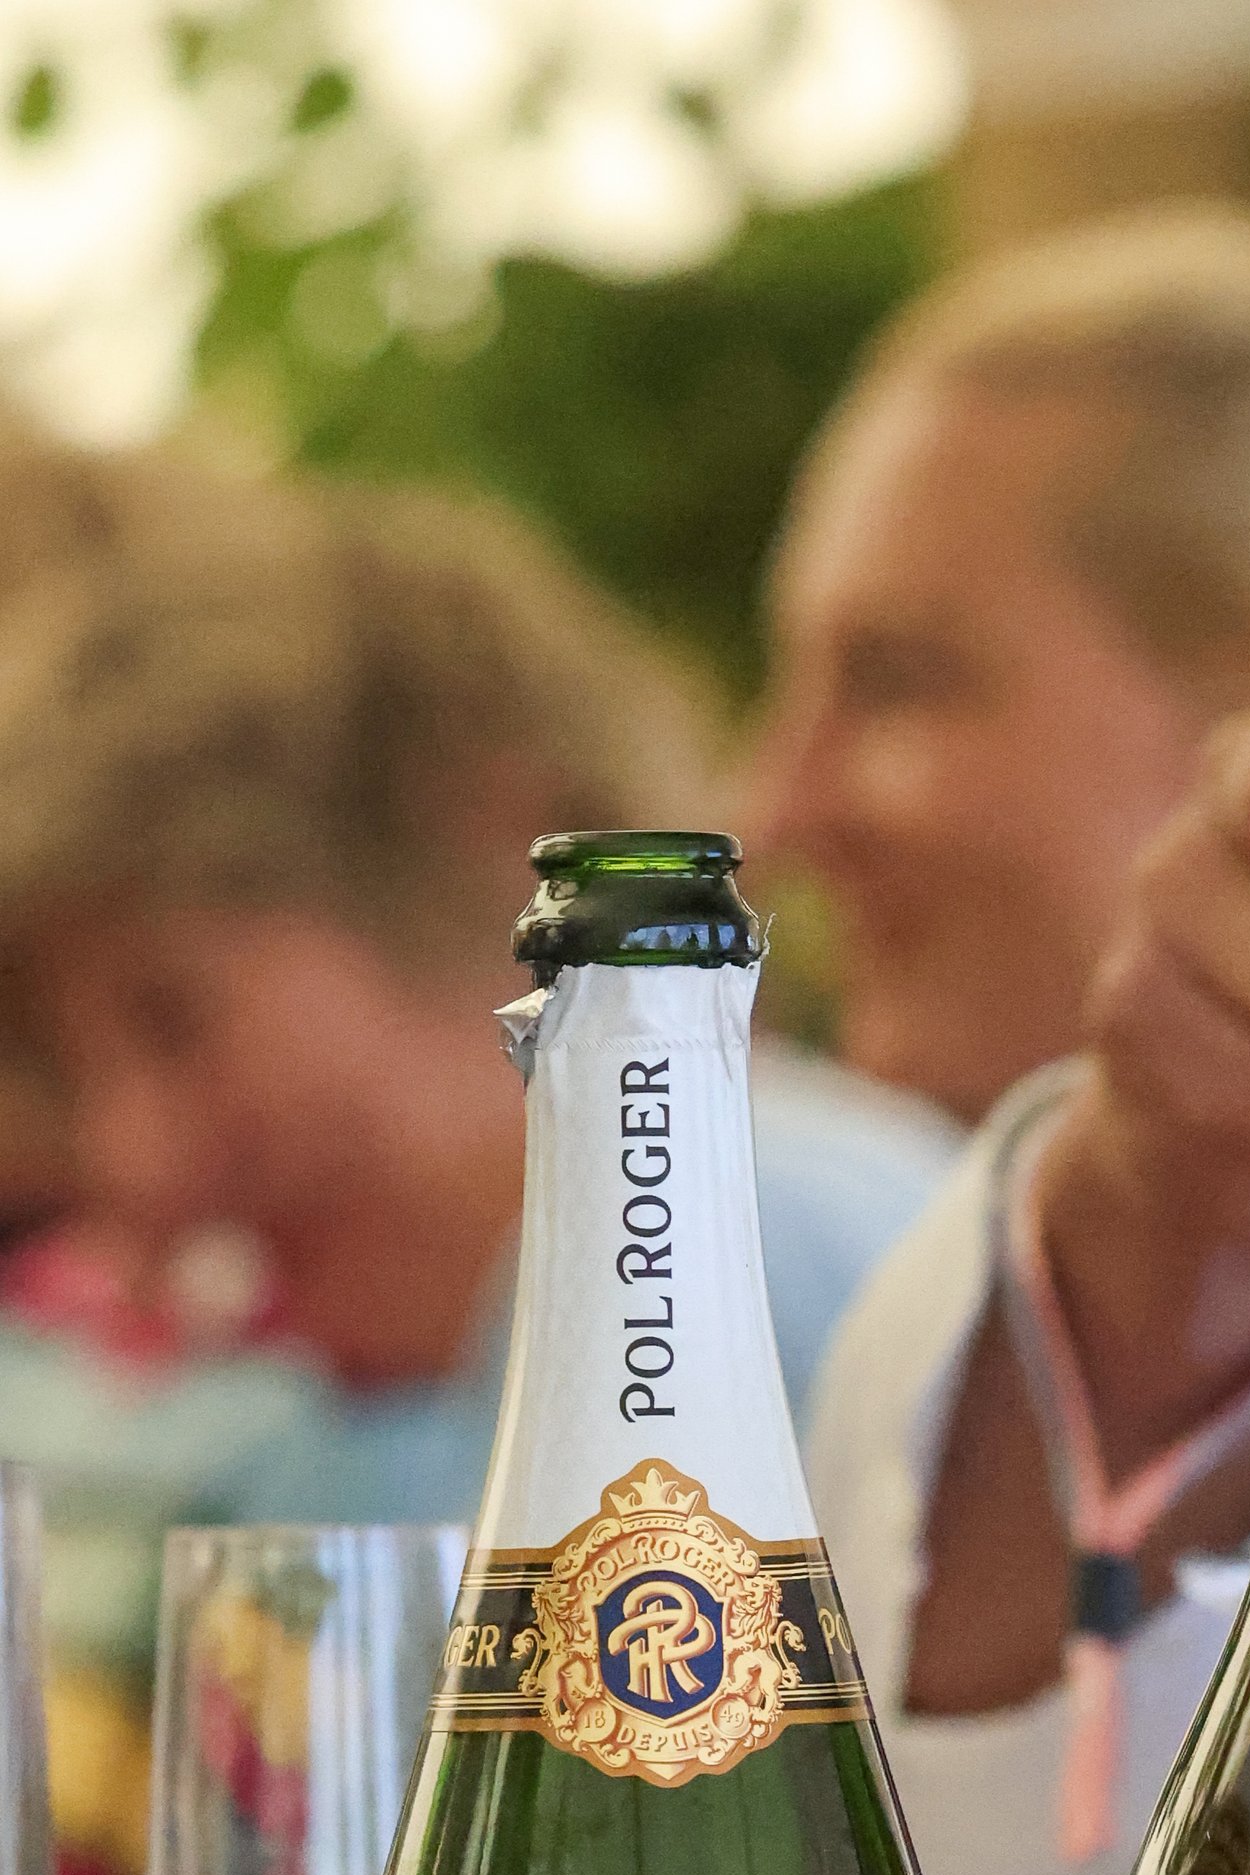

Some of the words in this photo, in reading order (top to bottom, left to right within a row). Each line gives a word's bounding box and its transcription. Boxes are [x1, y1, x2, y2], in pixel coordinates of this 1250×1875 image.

[616, 1056, 674, 1287] ROGER
[617, 1295, 677, 1424] POL
[576, 1552, 636, 1598] POL
[633, 1532, 737, 1593] ROGER
[615, 1724, 715, 1752] DEPUIS
